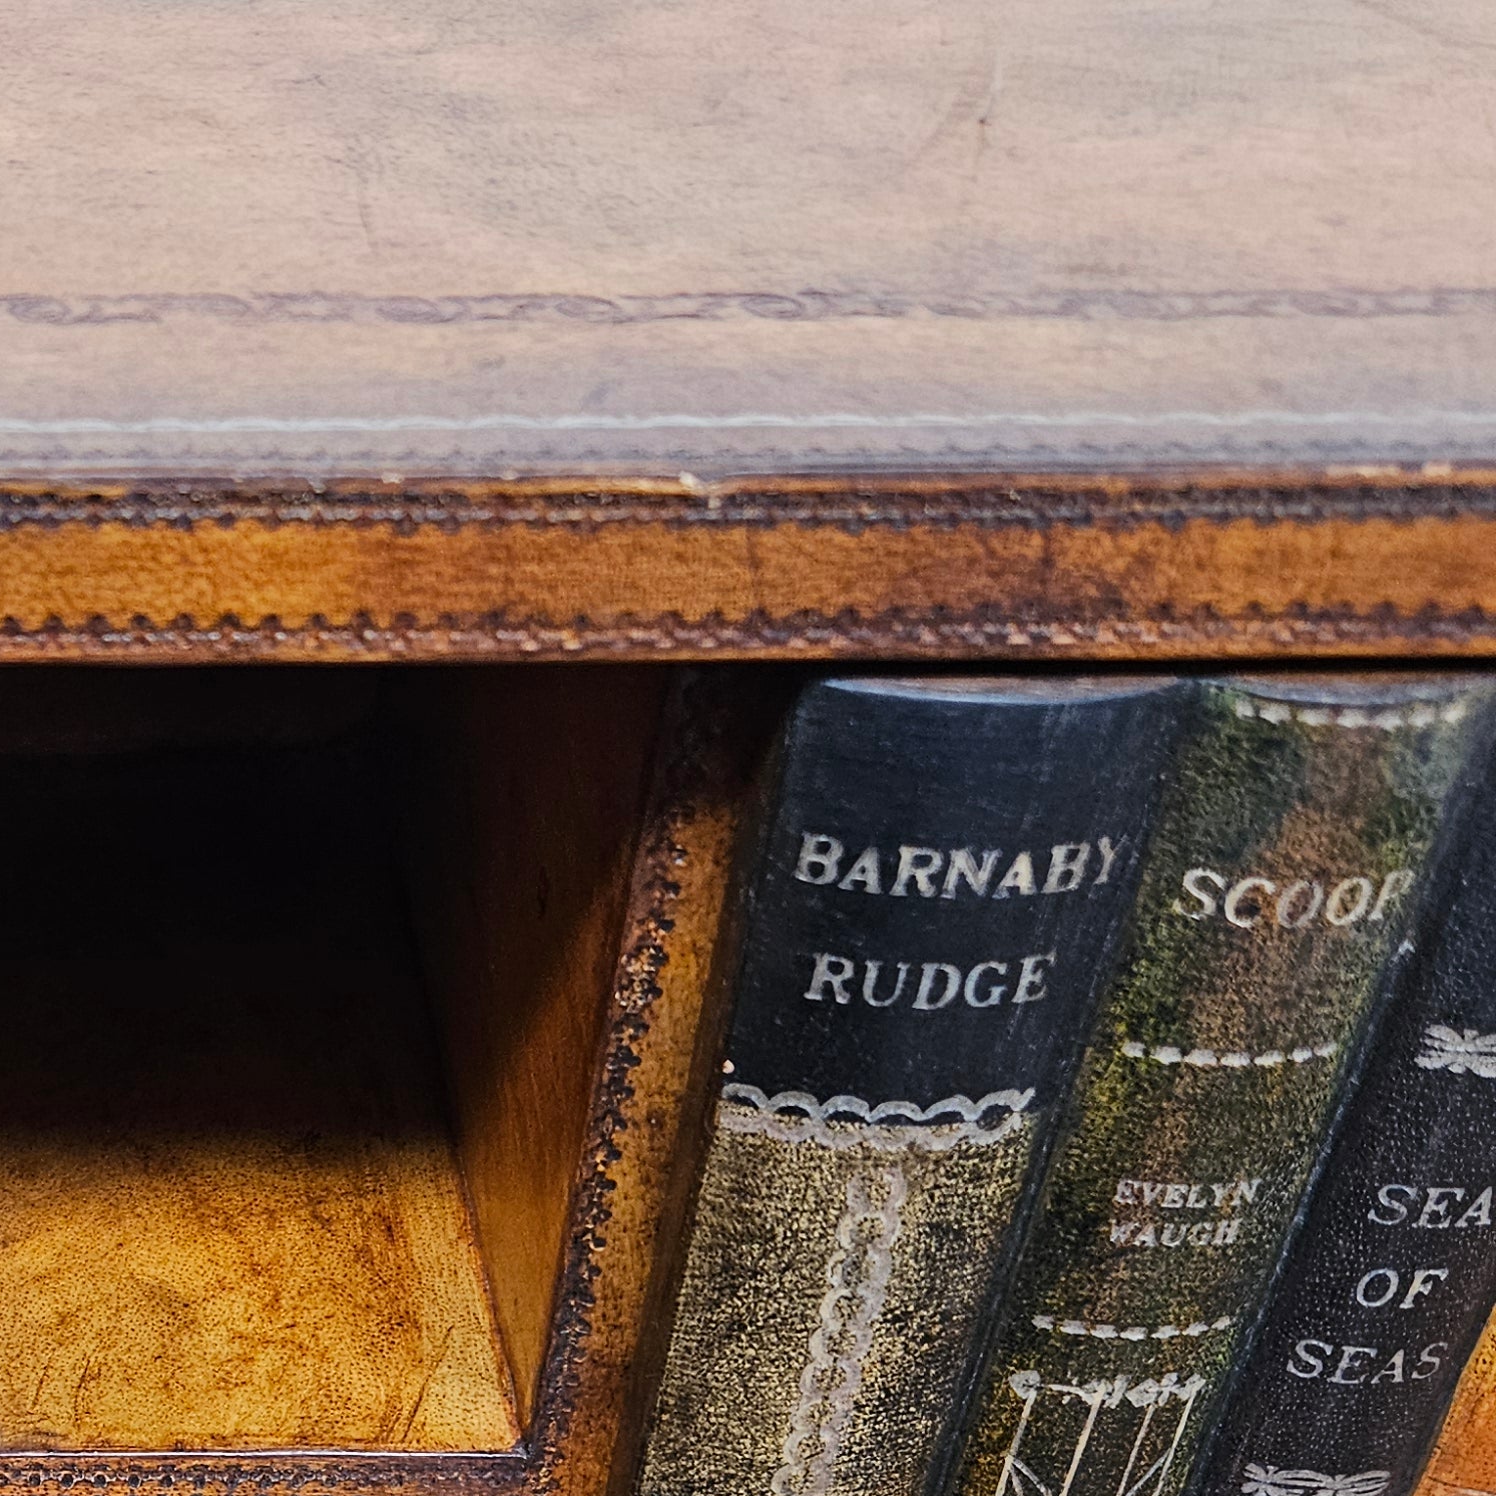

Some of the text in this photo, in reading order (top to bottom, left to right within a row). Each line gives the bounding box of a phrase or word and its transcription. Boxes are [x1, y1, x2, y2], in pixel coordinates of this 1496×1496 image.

[794, 832, 1131, 899] BARNABY
[1173, 868, 1416, 928] SCOOP
[803, 950, 1057, 1010] RUDGE
[1112, 1177, 1262, 1209] EVELYN
[1367, 1184, 1494, 1228] SEA
[1109, 1218, 1243, 1247] WAUGH
[1356, 1267, 1449, 1309] OF
[1286, 1338, 1448, 1384] SEAS
